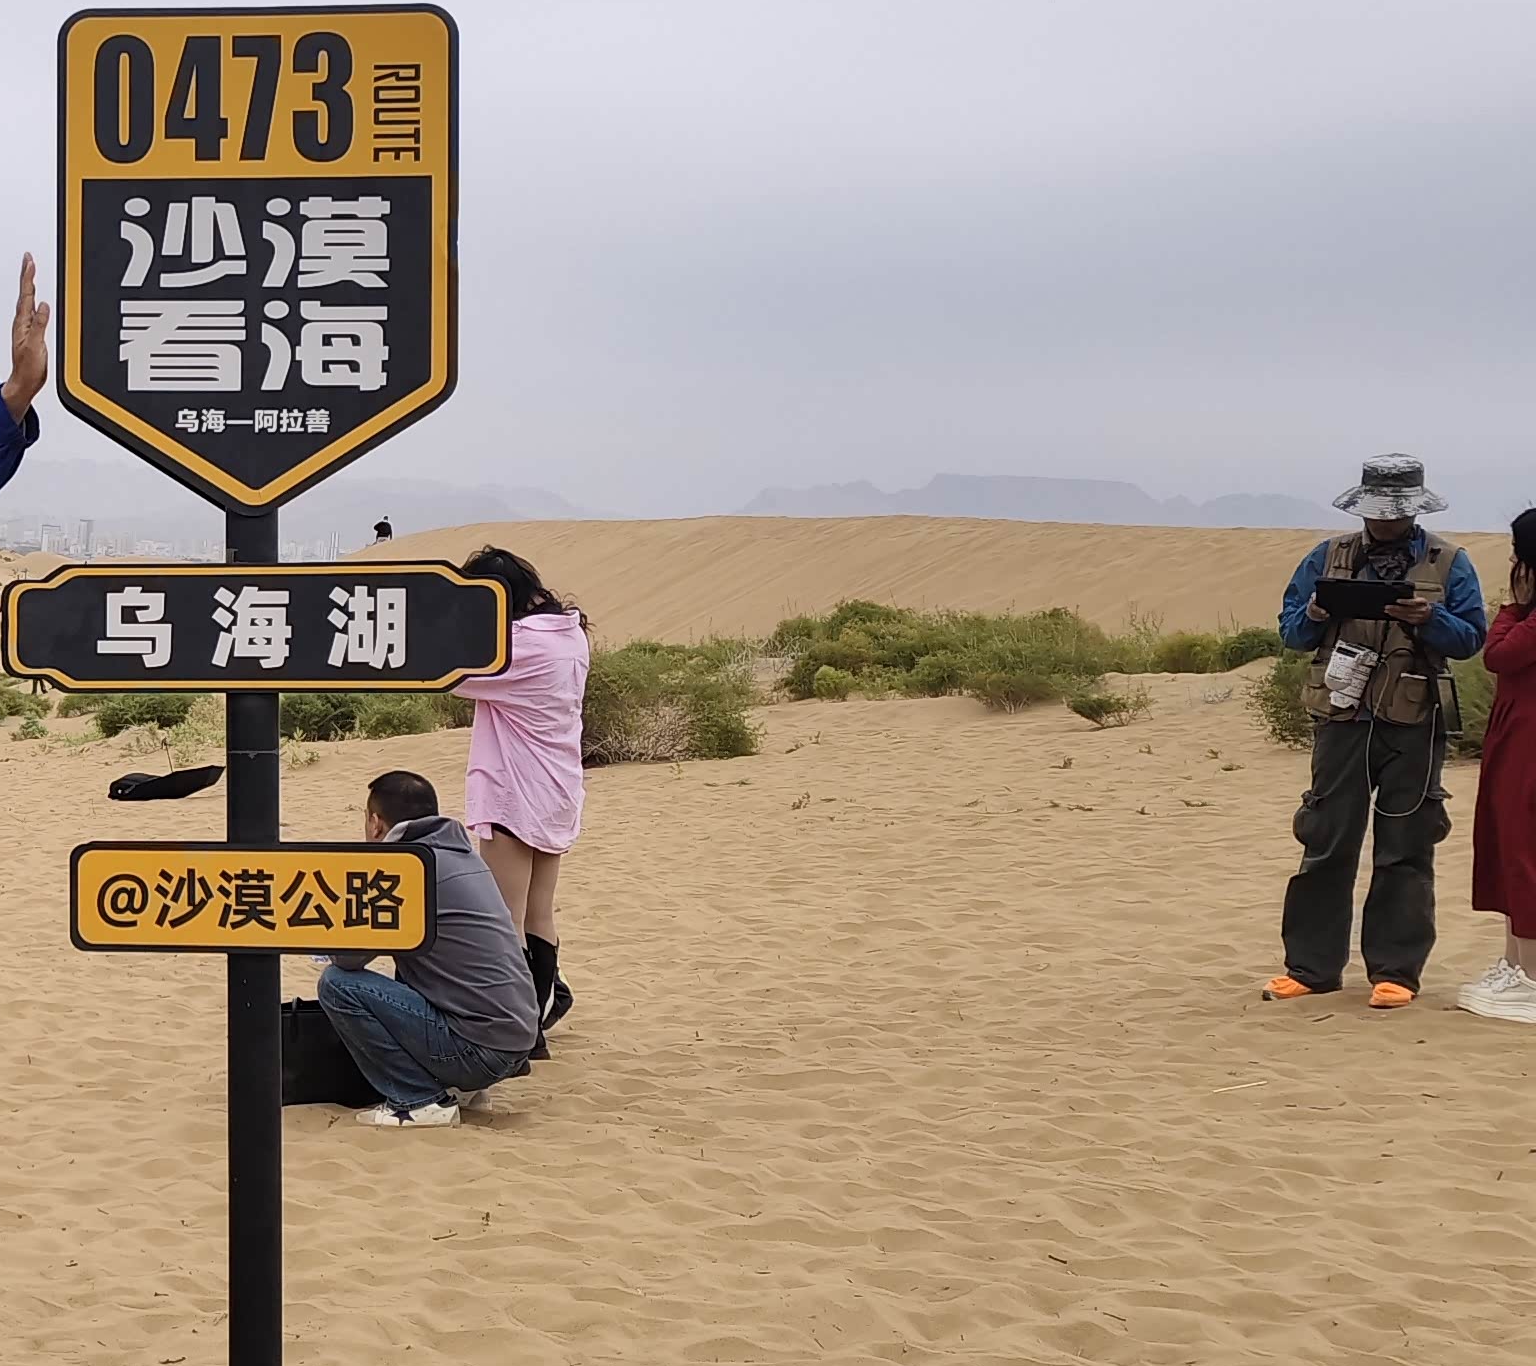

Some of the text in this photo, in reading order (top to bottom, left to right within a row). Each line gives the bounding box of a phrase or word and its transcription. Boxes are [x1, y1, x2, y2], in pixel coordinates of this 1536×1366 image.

[93, 31, 354, 164] 0473
[372, 63, 421, 163] ROUTE
[119, 196, 391, 288] 沙漠
[119, 300, 389, 392] 看海
[96, 585, 407, 670] 乌海湖
[96, 868, 405, 931] @沙漠公路
